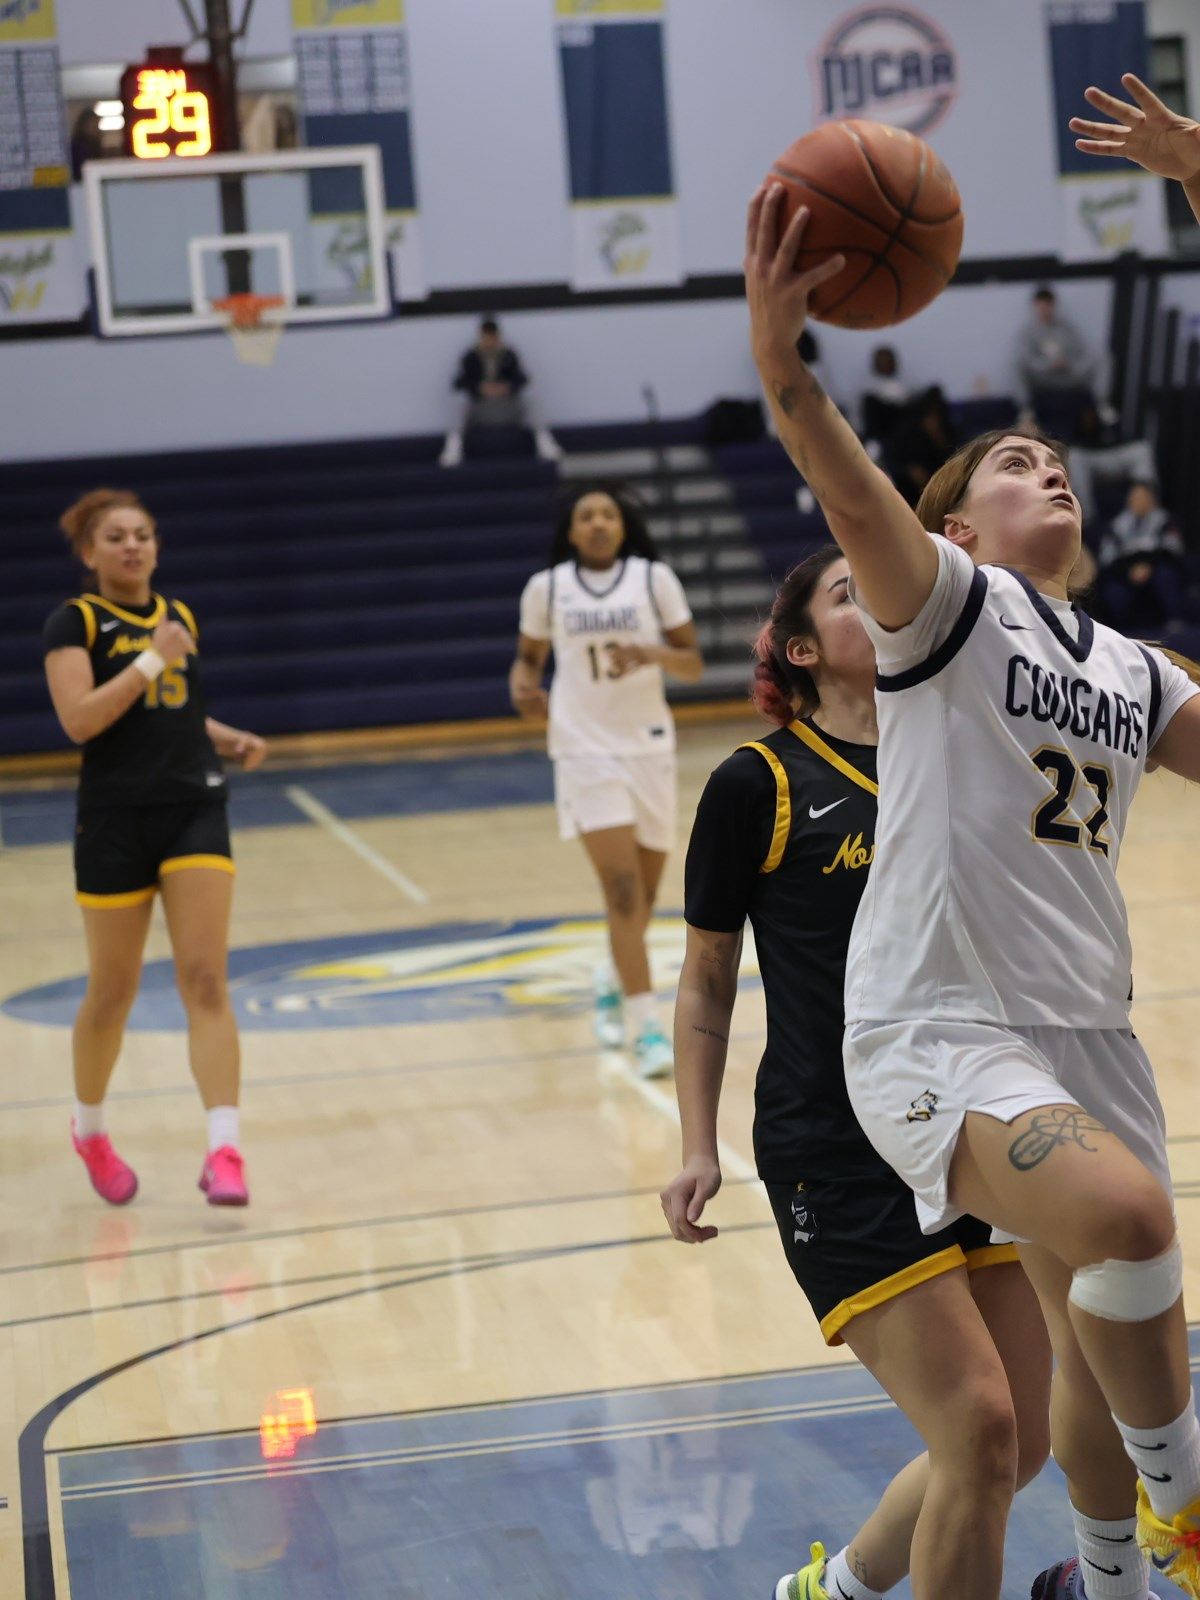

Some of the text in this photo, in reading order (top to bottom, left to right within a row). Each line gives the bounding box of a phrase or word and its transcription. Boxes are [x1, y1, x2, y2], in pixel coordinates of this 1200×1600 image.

[132, 91, 212, 159] 29
[821, 51, 955, 115] NJCAA
[1006, 654, 1143, 759] COUGARS
[1031, 743, 1114, 857] 22
